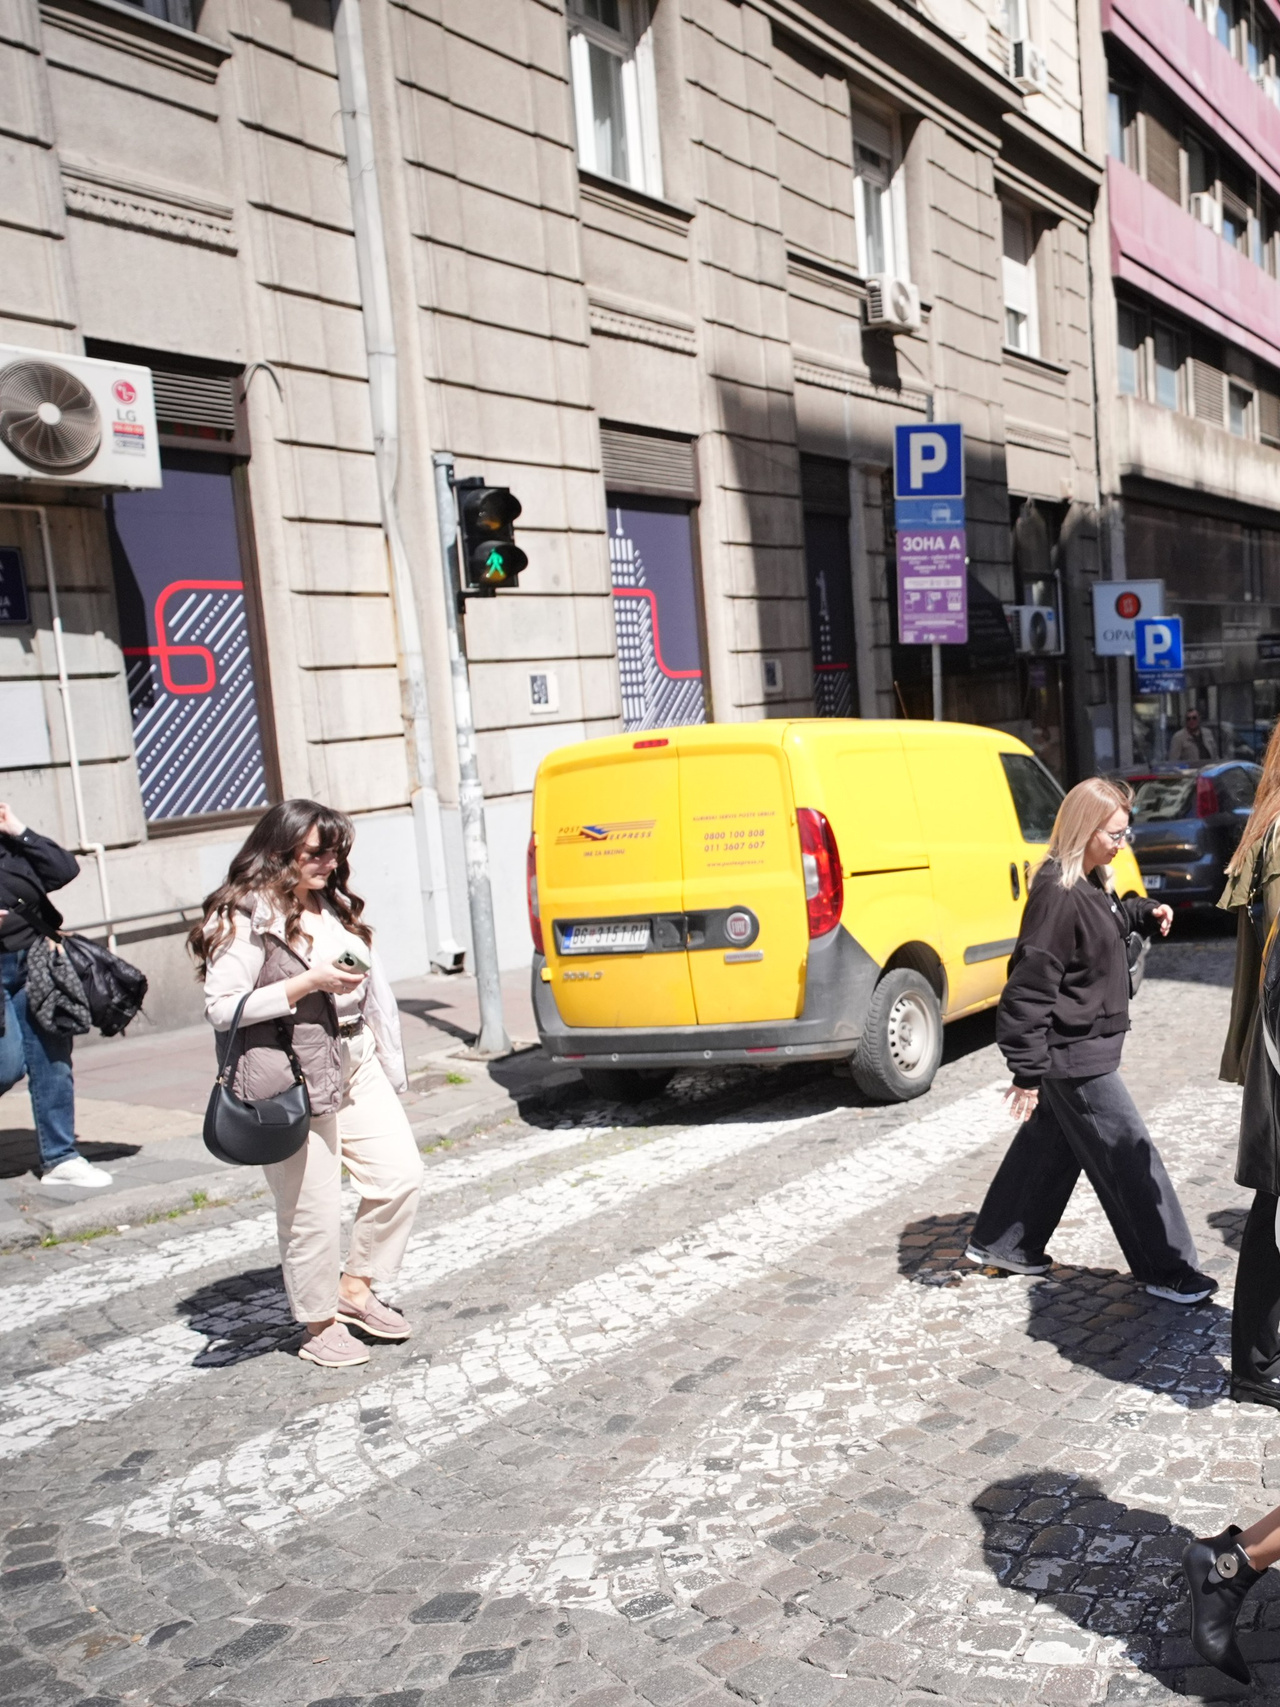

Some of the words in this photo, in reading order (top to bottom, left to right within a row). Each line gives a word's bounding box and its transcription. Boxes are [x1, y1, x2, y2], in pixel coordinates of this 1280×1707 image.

[117, 408, 137, 423] LG
[909, 431, 948, 490] P
[902, 536, 946, 552] ЗОНА
[949, 535, 962, 550] А
[1144, 624, 1172, 665] P
[609, 831, 652, 840] EXPRESS
[704, 832, 725, 840] 0800
[729, 830, 745, 838] 100
[748, 829, 765, 837] 808
[704, 844, 719, 852] 011
[723, 842, 746, 851] 3607
[748, 841, 765, 849] 607
[731, 920, 746, 933] FIAT
[573, 927, 588, 944] BG
